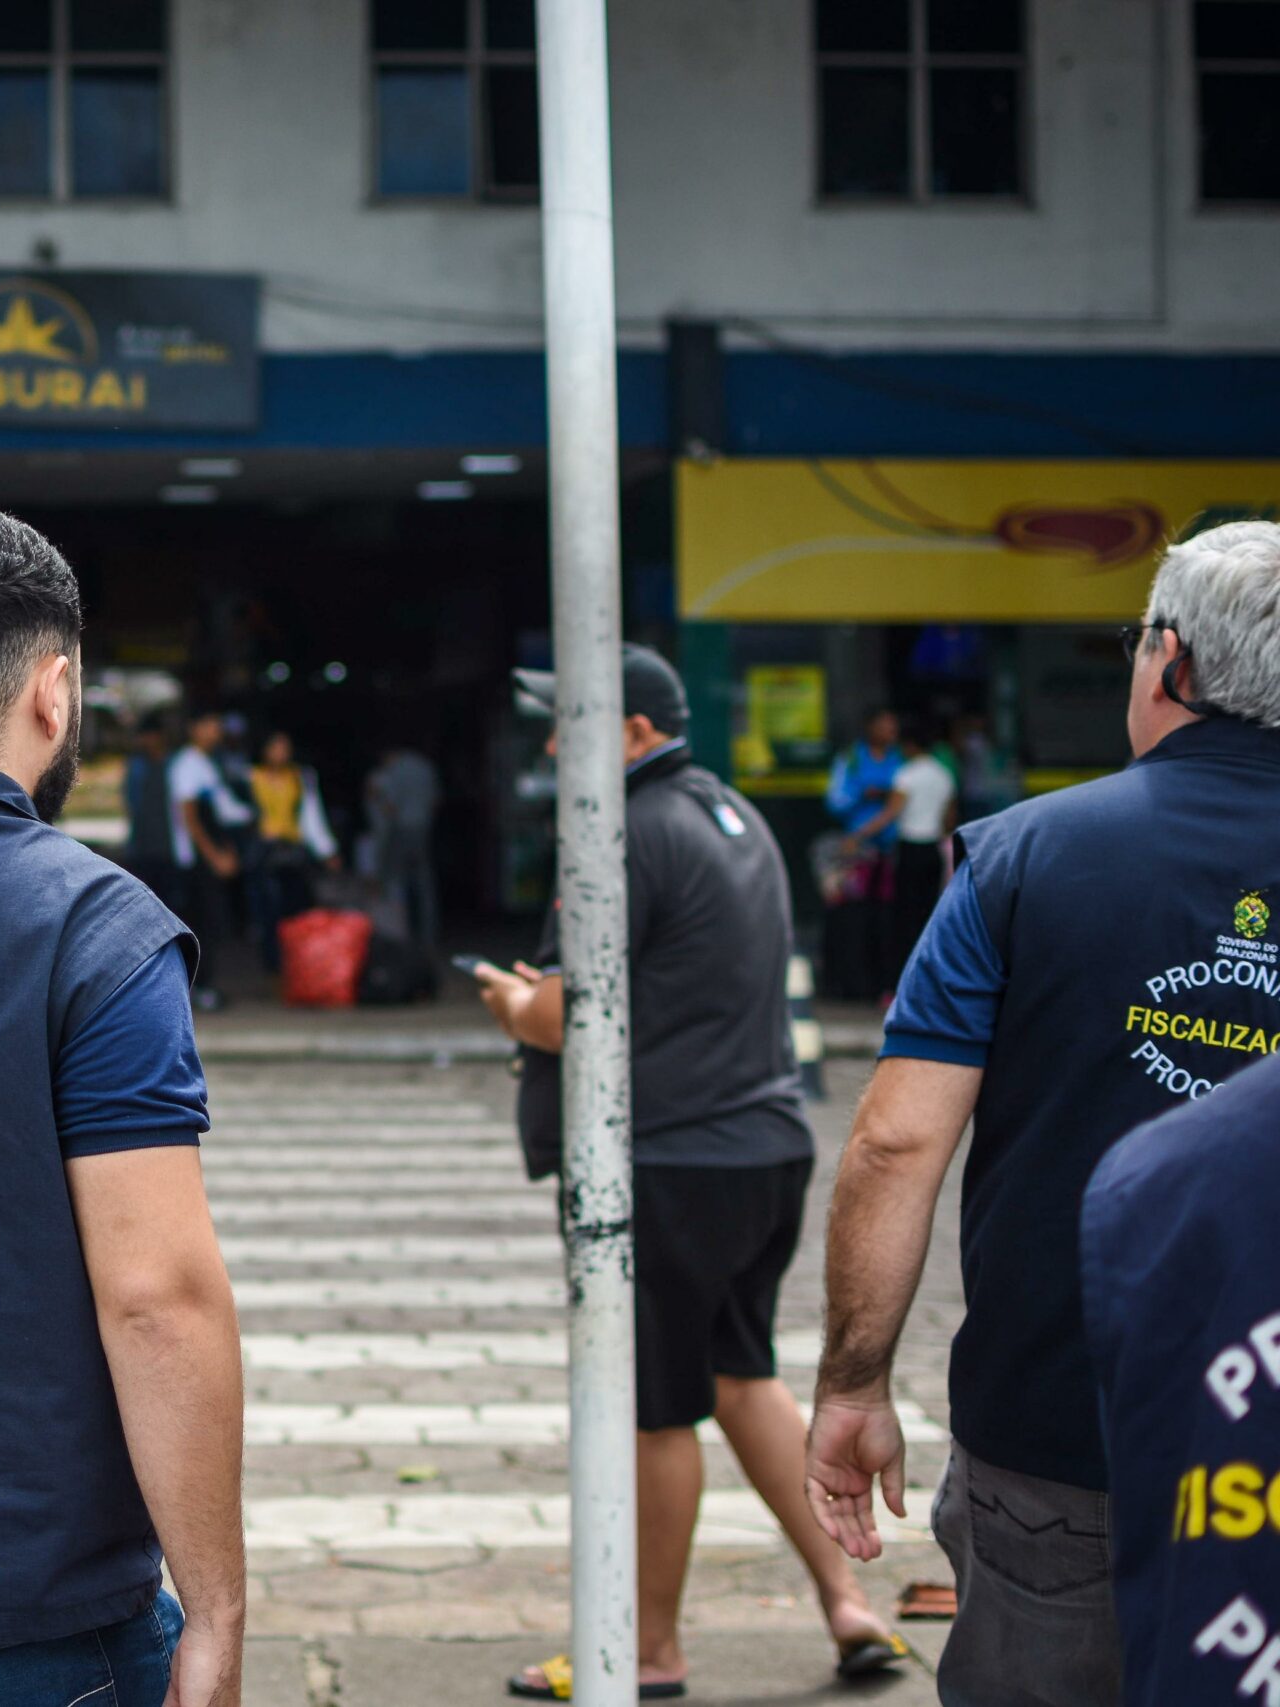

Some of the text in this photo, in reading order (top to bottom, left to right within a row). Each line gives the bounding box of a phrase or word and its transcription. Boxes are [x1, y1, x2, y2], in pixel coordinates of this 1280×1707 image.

[1216, 934, 1279, 954] GOVERNO DO
[1215, 945, 1277, 964] AMAZONAS
[1130, 1039, 1228, 1100] PROC
